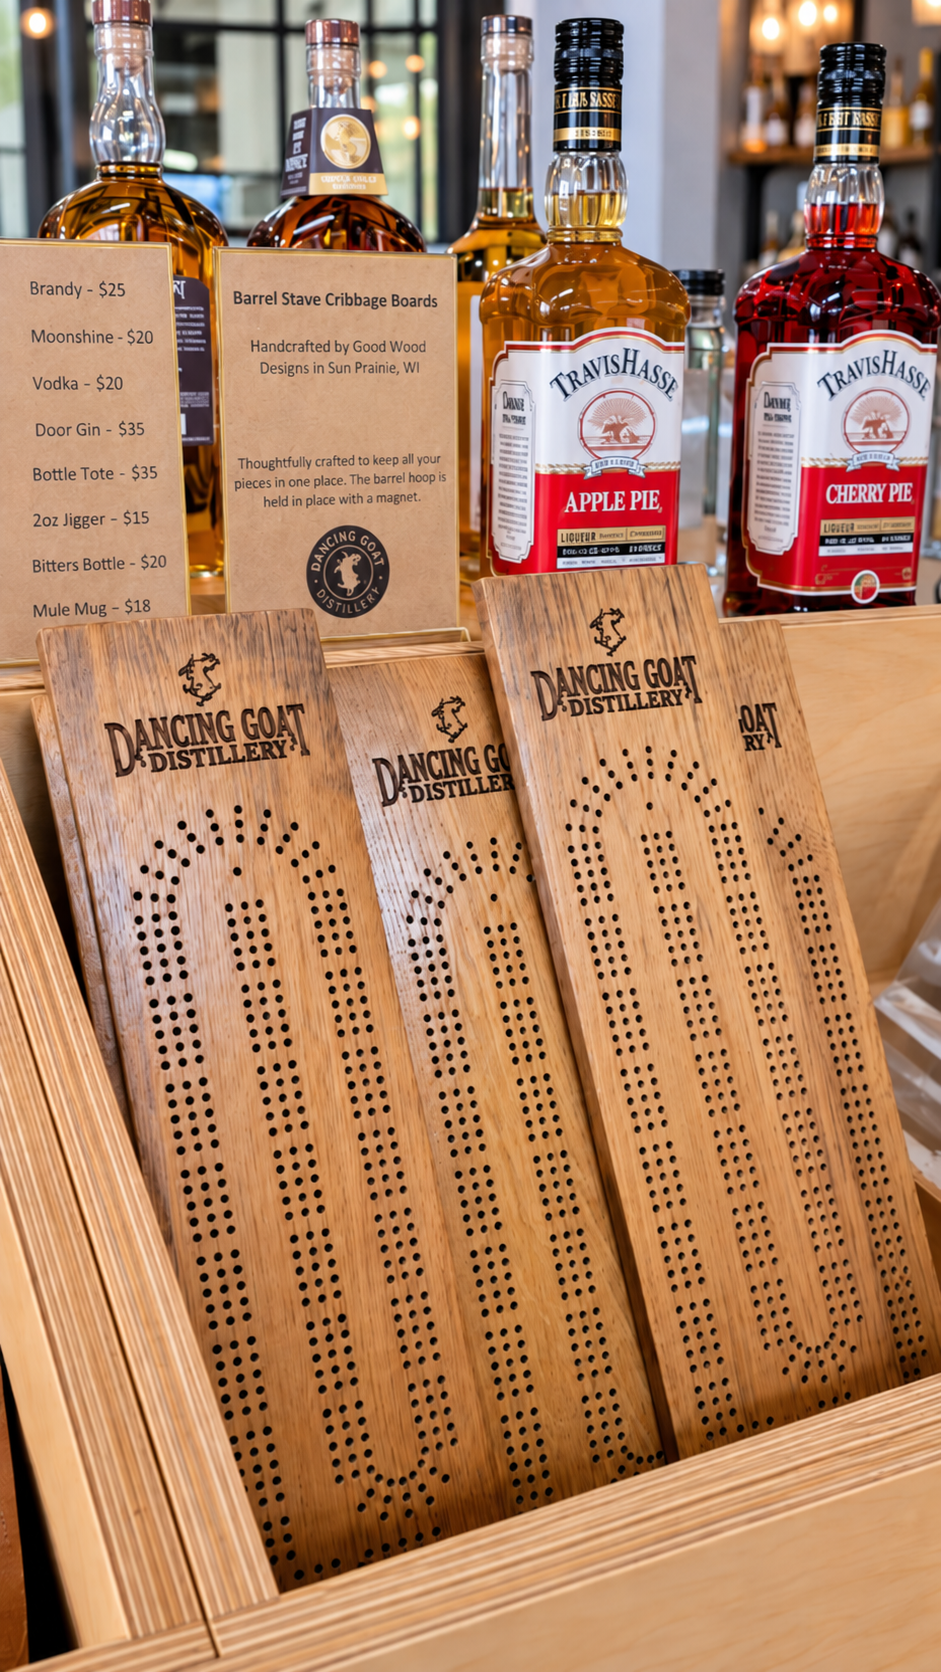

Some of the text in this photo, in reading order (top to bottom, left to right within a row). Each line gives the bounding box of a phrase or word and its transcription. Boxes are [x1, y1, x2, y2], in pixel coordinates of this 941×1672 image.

[29, 280, 83, 300] Brandy
[98, 280, 126, 299] $25
[233, 290, 438, 311] Barrel Stave Cribbage Boards
[30, 328, 114, 345] Moonshine
[126, 328, 154, 346] $20
[250, 339, 427, 356] Handcrafted by Good Wood
[259, 361, 310, 378] Designs
[313, 361, 325, 374] in
[328, 361, 352, 375] Sun
[402, 361, 420, 374] WI
[32, 375, 79, 391] Vodka
[96, 373, 124, 393] $20
[35, 422, 73, 437] Door
[75, 422, 101, 437] Gin
[118, 420, 145, 438] $35
[32, 466, 77, 482] Bottle
[79, 466, 115, 481] Tote
[131, 463, 158, 482] $35
[237, 453, 442, 472] Thoughtfully crafted to keep all your
[234, 471, 447, 492] pieces in one place. The barrel hoop is
[263, 492, 421, 509] held in place with a magnet.
[564, 489, 660, 513] APPLE PIE
[825, 482, 913, 505] CHERRY PIE
[32, 513, 59, 528] 2oz
[62, 512, 106, 530] Jigger
[123, 509, 150, 527] $15
[310, 530, 385, 572] DANCING GOAT
[32, 558, 80, 574] Bitters
[82, 556, 126, 572] Bottle
[140, 553, 167, 571] $20
[32, 602, 71, 618] Mule
[74, 601, 108, 618] Mug
[124, 598, 151, 615] $18
[316, 587, 380, 614] DISTILLERY
[530, 655, 703, 721] DANCING GOAT
[570, 688, 683, 717] DISTILLERY
[738, 702, 782, 748] OAT
[104, 703, 310, 777] DANCING GOAT
[148, 739, 288, 772] DISTILLERY
[372, 742, 512, 807] DANCING GO
[408, 773, 516, 803] DISTILLER
